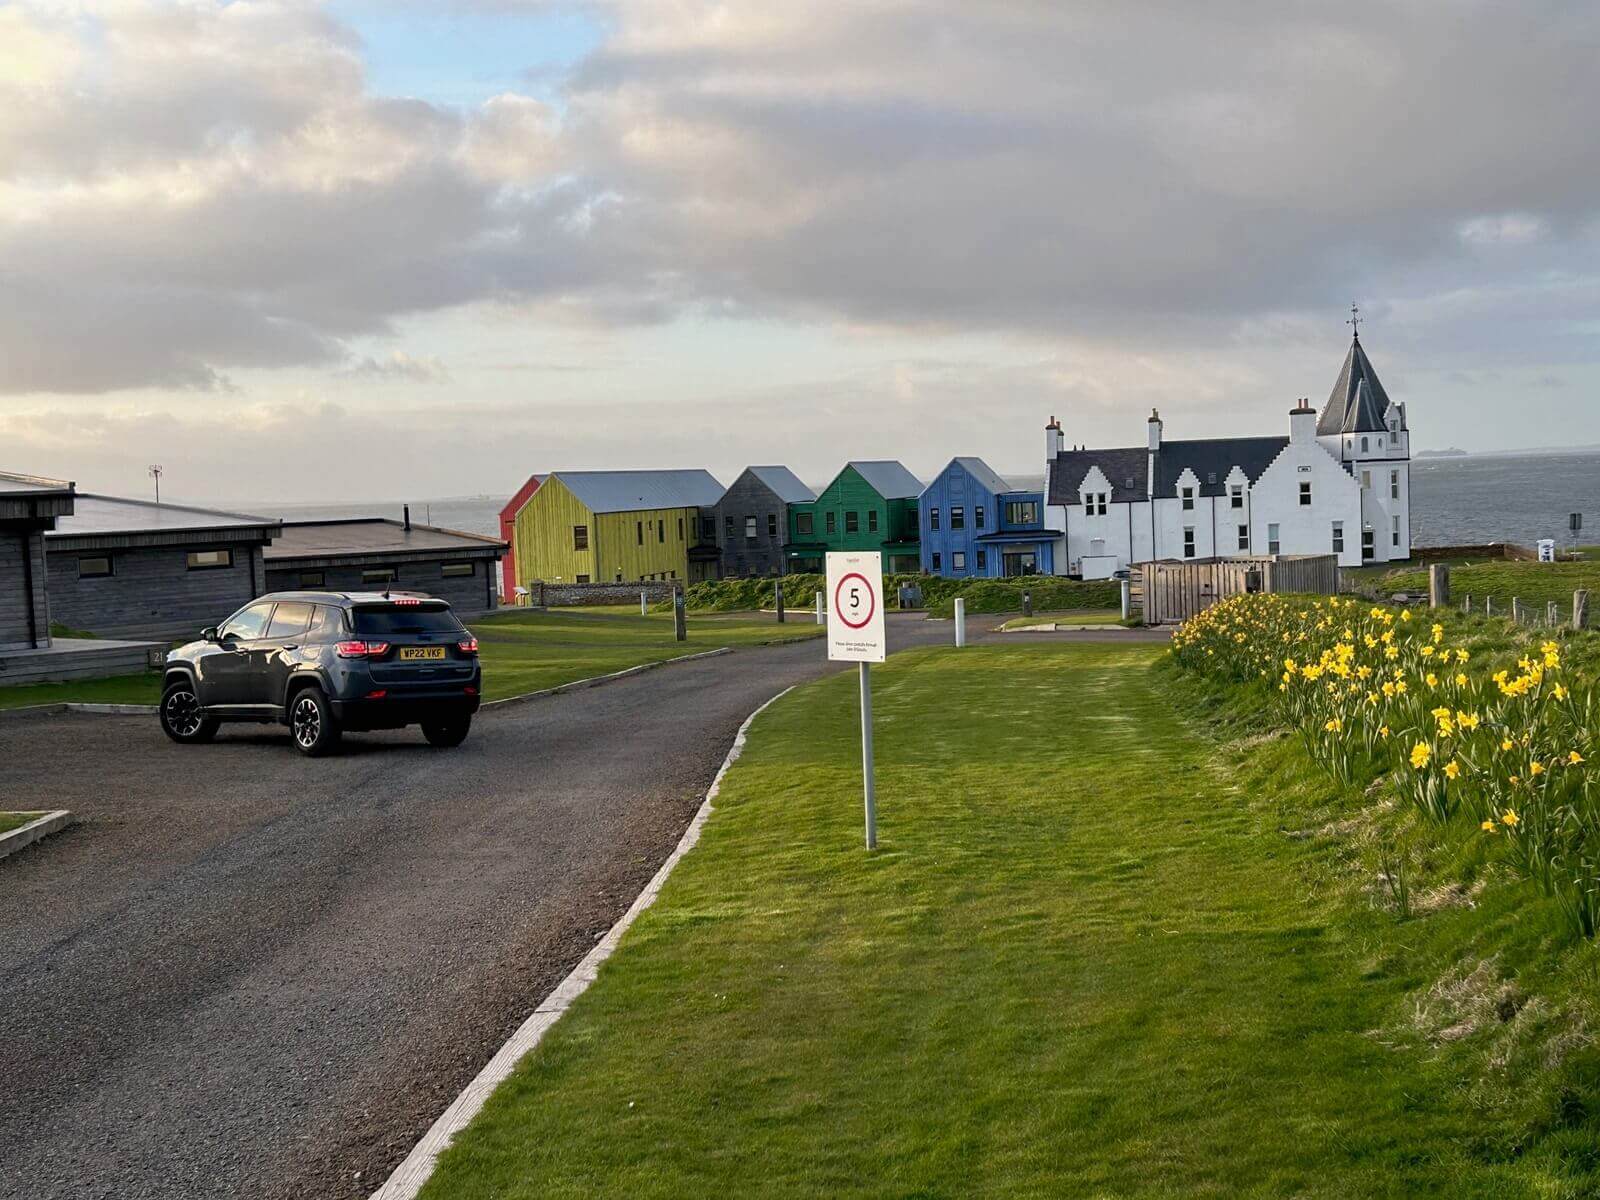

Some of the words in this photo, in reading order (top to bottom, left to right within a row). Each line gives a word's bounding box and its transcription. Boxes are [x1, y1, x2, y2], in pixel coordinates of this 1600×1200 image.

[850, 588, 859, 608] 5
[154, 652, 163, 662] 21
[404, 649, 425, 658] WP22
[427, 648, 441, 658] VKF
